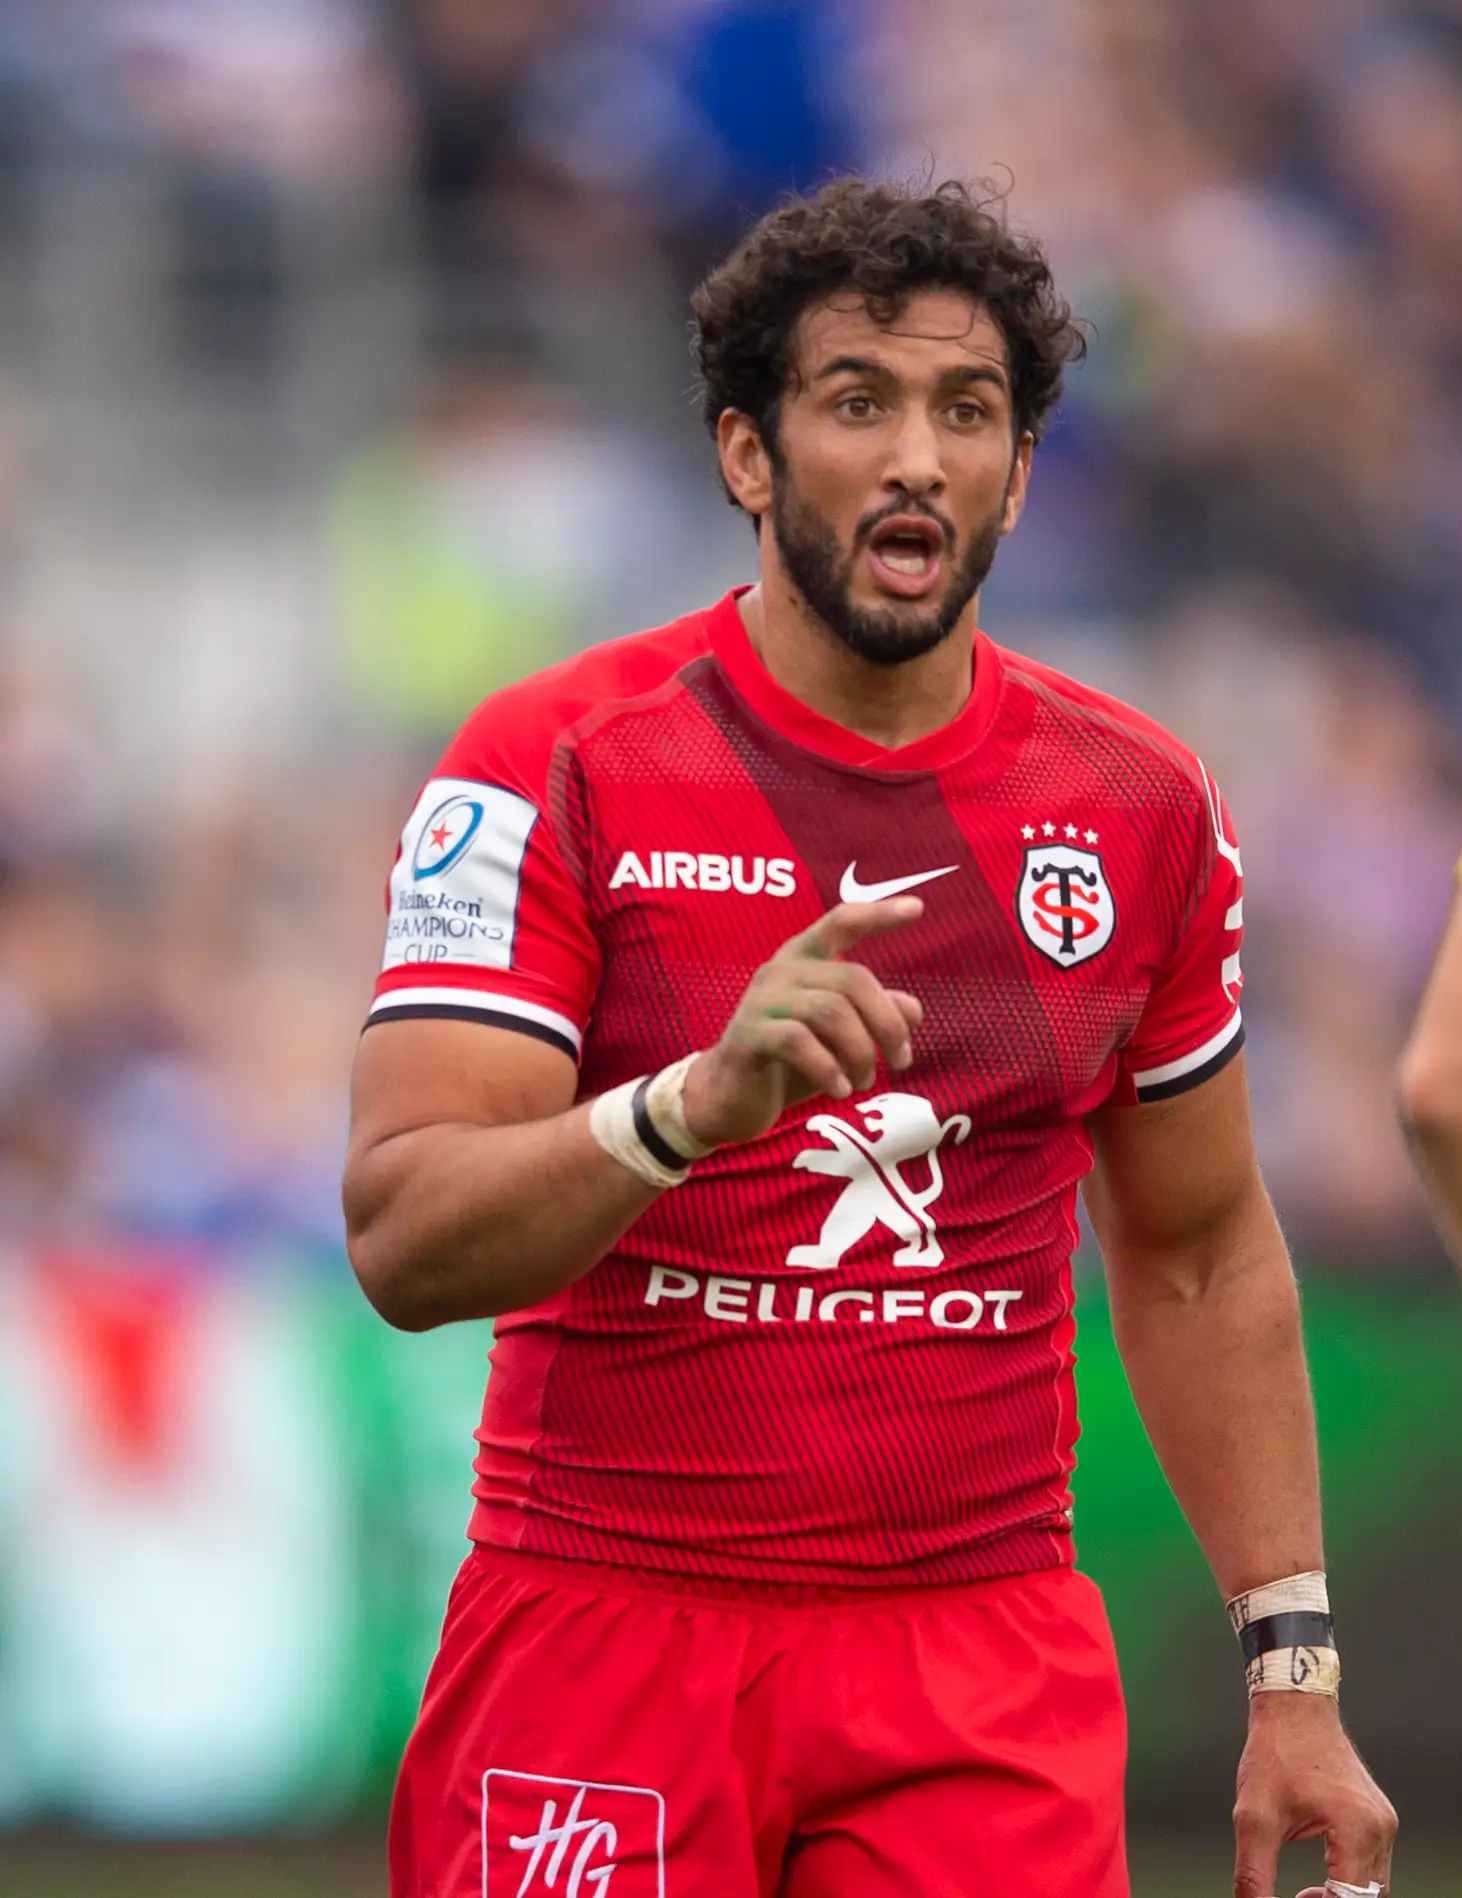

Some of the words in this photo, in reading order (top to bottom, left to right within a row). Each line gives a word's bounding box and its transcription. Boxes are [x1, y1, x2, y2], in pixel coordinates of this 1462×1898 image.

[609, 851, 796, 897] AIRBUS
[398, 889, 482, 919] Heineken
[388, 916, 504, 941] HAMPIONS
[404, 943, 448, 964] CUP
